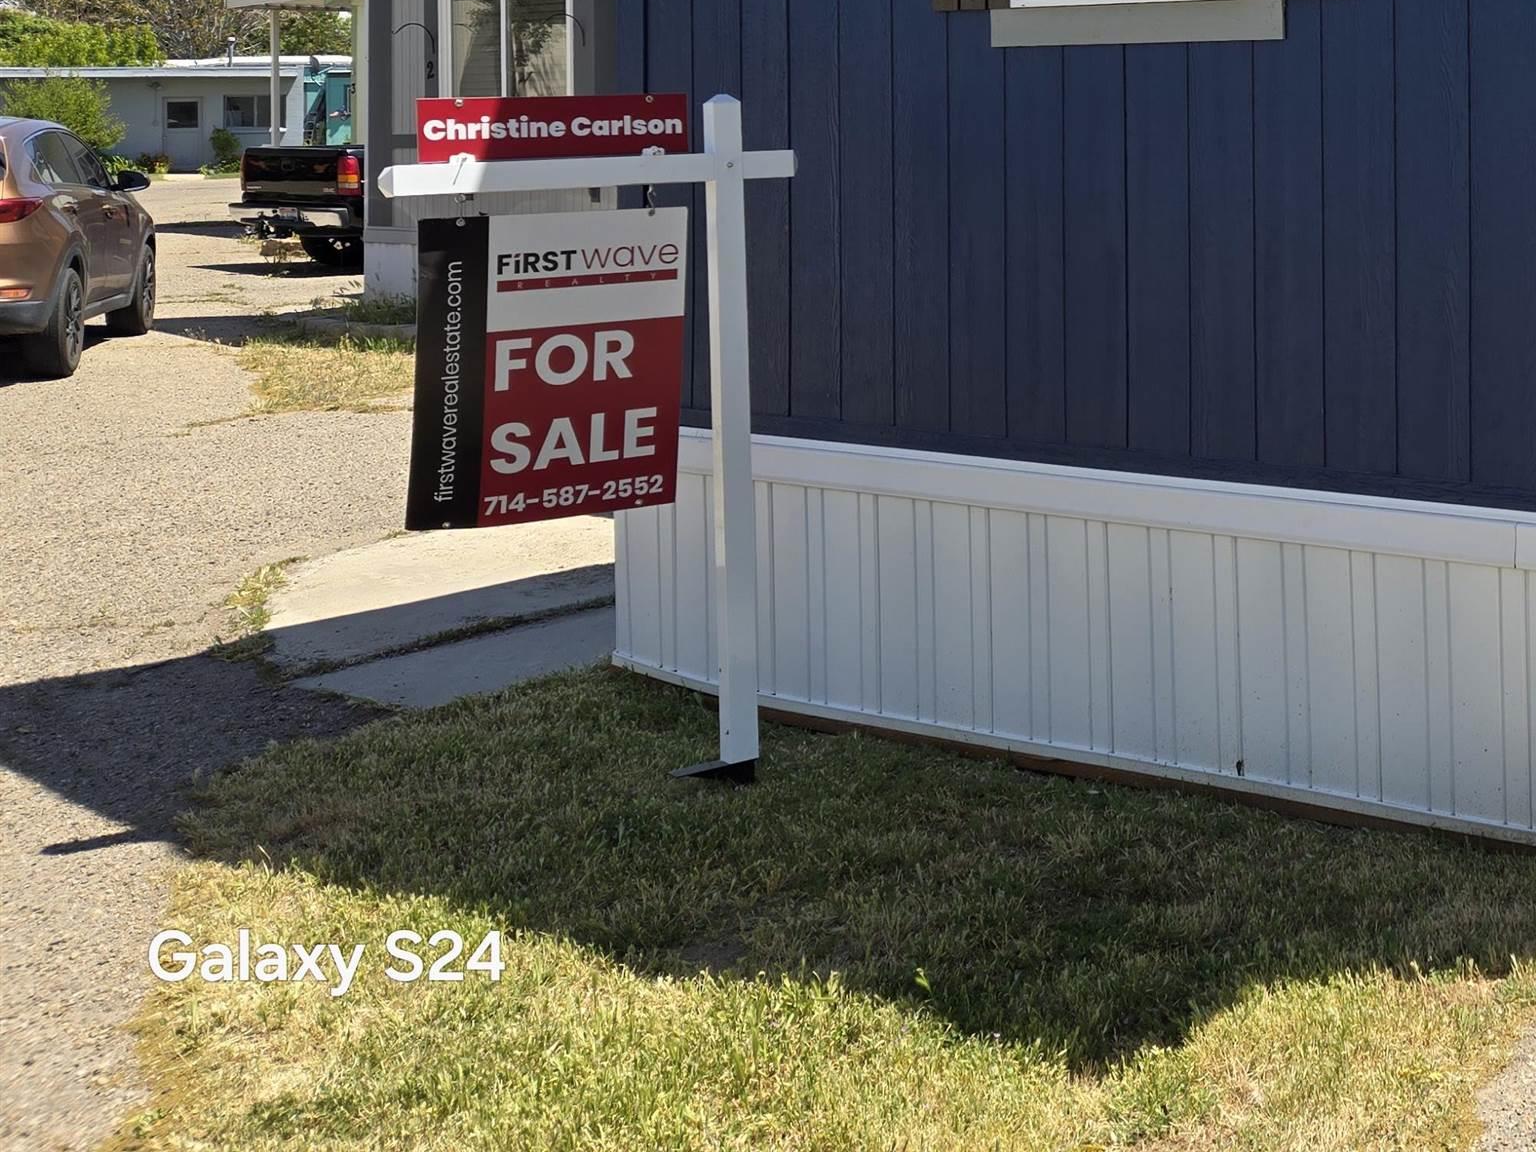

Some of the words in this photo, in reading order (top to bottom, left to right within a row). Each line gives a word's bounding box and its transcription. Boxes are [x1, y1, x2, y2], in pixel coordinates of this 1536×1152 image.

[422, 115, 567, 141] Christine
[570, 115, 684, 138] Carlson
[516, 272, 658, 290] REALTY
[433, 260, 463, 503] firstwaverealestate.com
[494, 329, 635, 393] FOR
[489, 406, 658, 475] SALE
[483, 474, 665, 516] 714-587-2552
